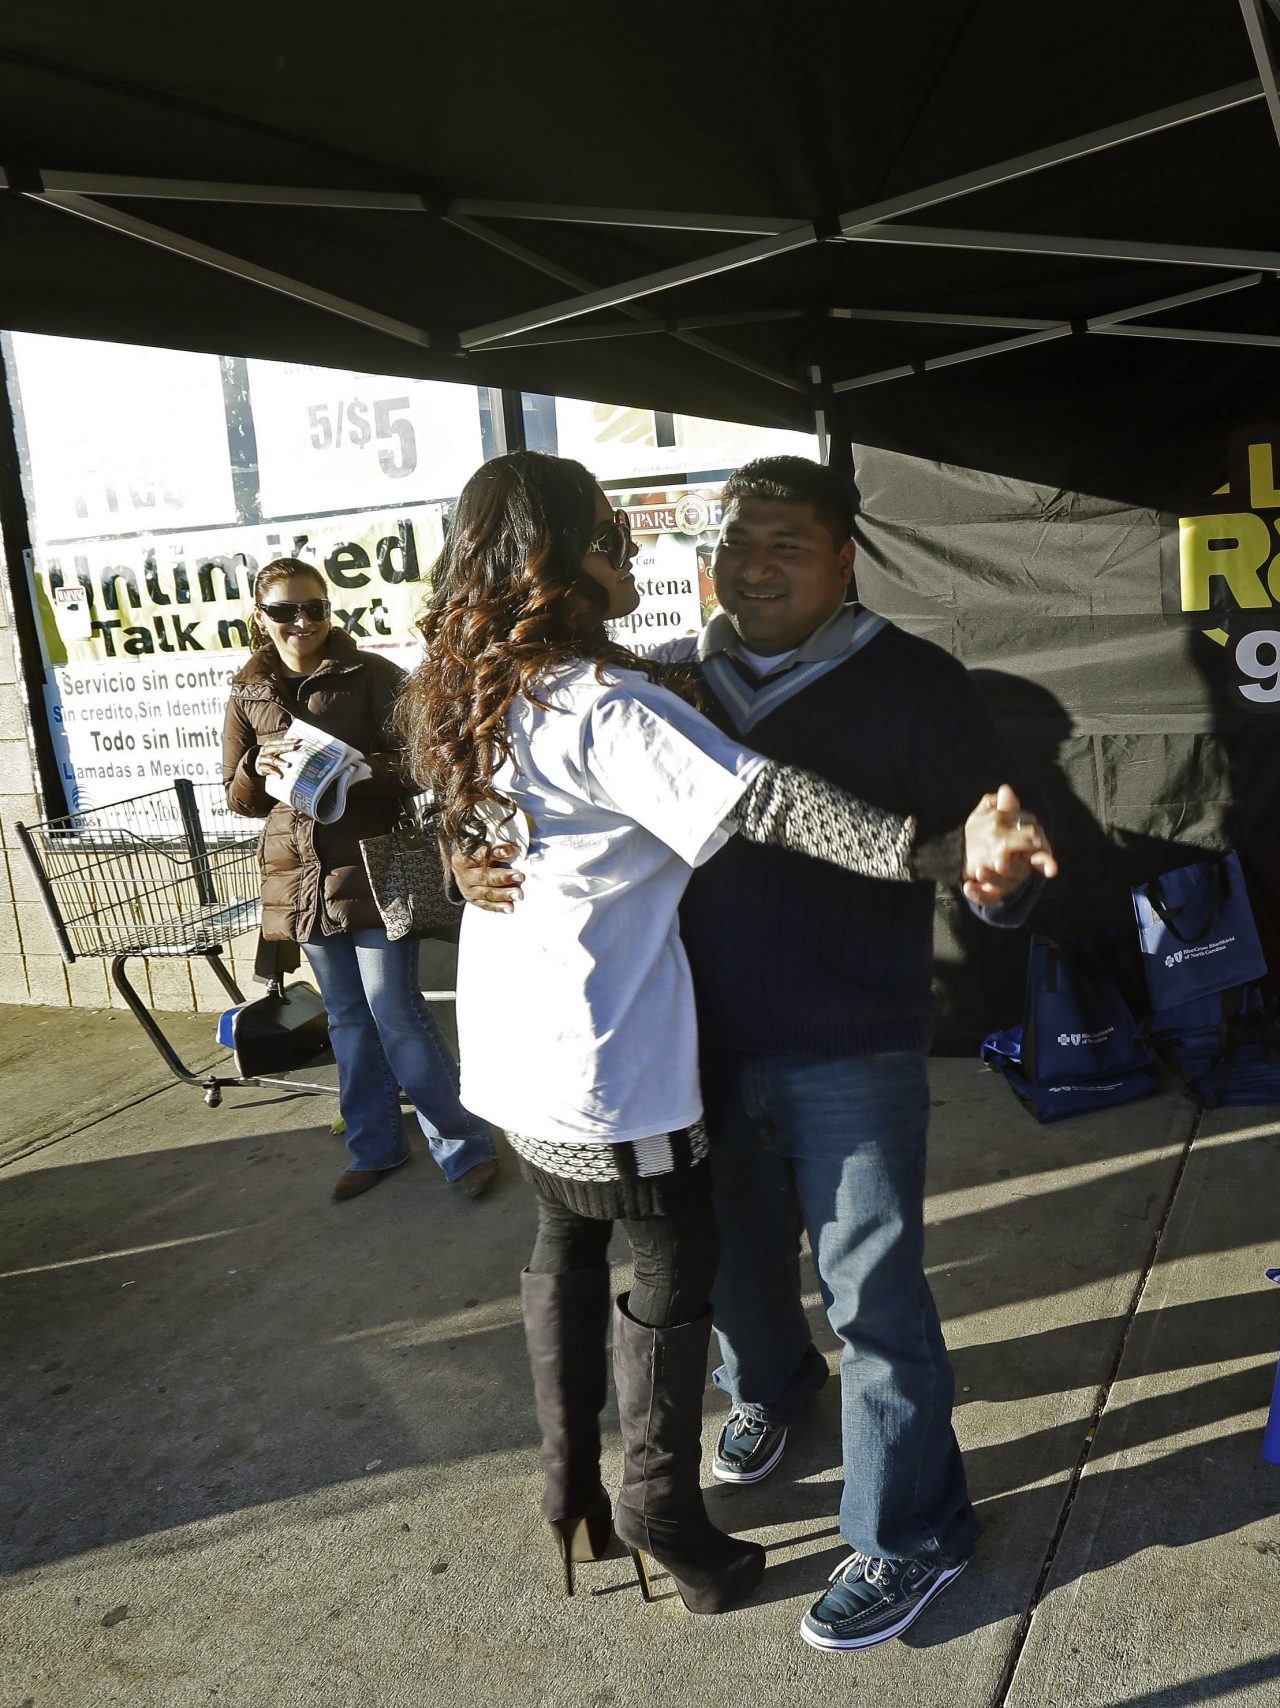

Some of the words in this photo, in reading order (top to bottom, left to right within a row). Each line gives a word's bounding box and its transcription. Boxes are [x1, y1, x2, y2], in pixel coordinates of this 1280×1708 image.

[308, 396, 418, 478] 5/$5
[636, 556, 655, 566] Can
[637, 578, 693, 597] stena
[91, 614, 206, 657] Talk
[333, 598, 391, 637] xt
[613, 611, 681, 633] apeno
[63, 671, 135, 695] Servicio
[142, 670, 169, 691] sin
[53, 705, 76, 723] Sin
[90, 730, 136, 752] Todo
[143, 728, 170, 750] sin
[176, 726, 224, 748] limit
[63, 760, 132, 780] Llamadas
[137, 764, 146, 777] a
[150, 759, 210, 779] Mexico,
